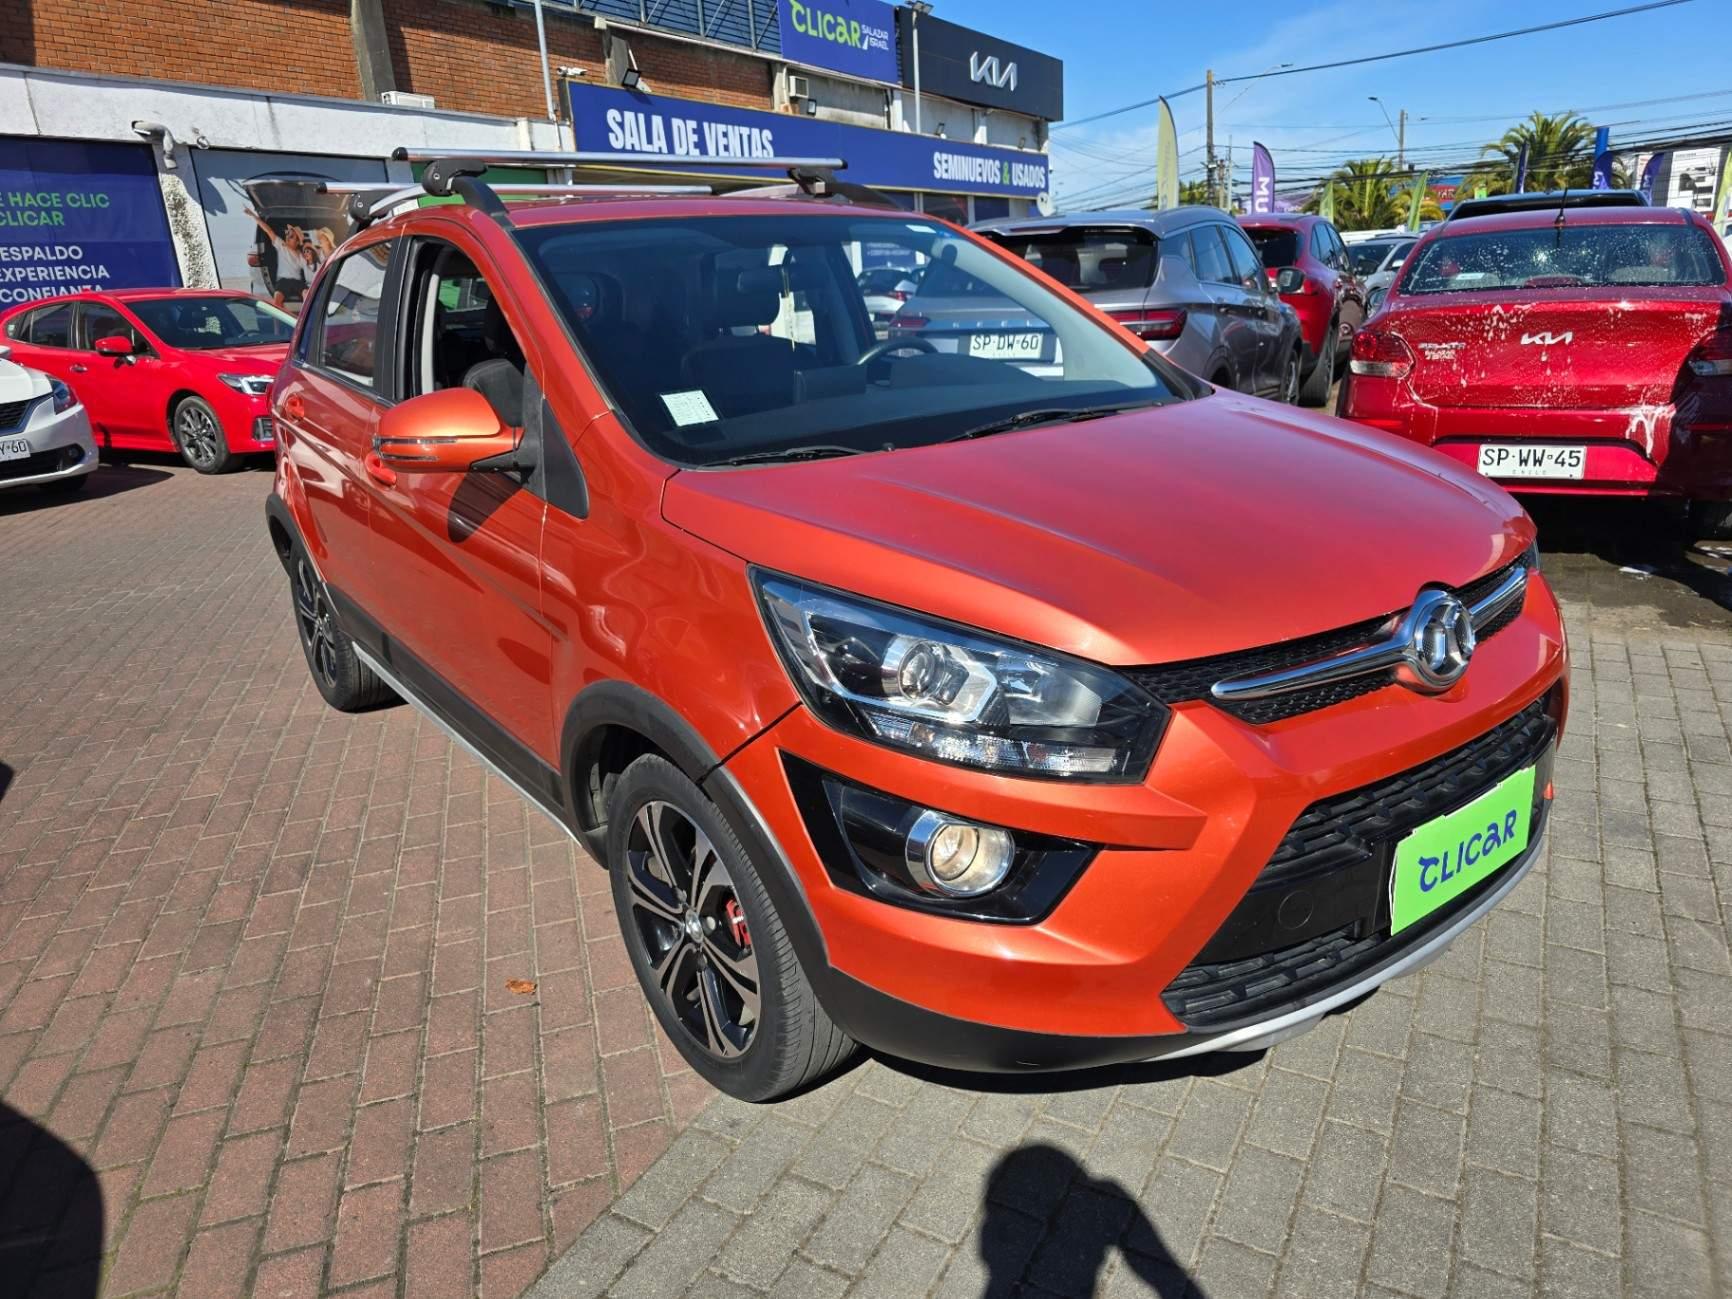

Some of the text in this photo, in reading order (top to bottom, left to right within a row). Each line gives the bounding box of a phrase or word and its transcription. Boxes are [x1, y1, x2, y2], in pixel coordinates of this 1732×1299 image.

[969, 51, 1017, 92] KIA
[606, 108, 774, 158] SALA DE VENTAS
[933, 151, 1046, 189] SEMINUEVOS & USADOS
[7, 192, 63, 209] HACE
[66, 193, 110, 208] CLIC
[1520, 331, 1573, 345] KIA
